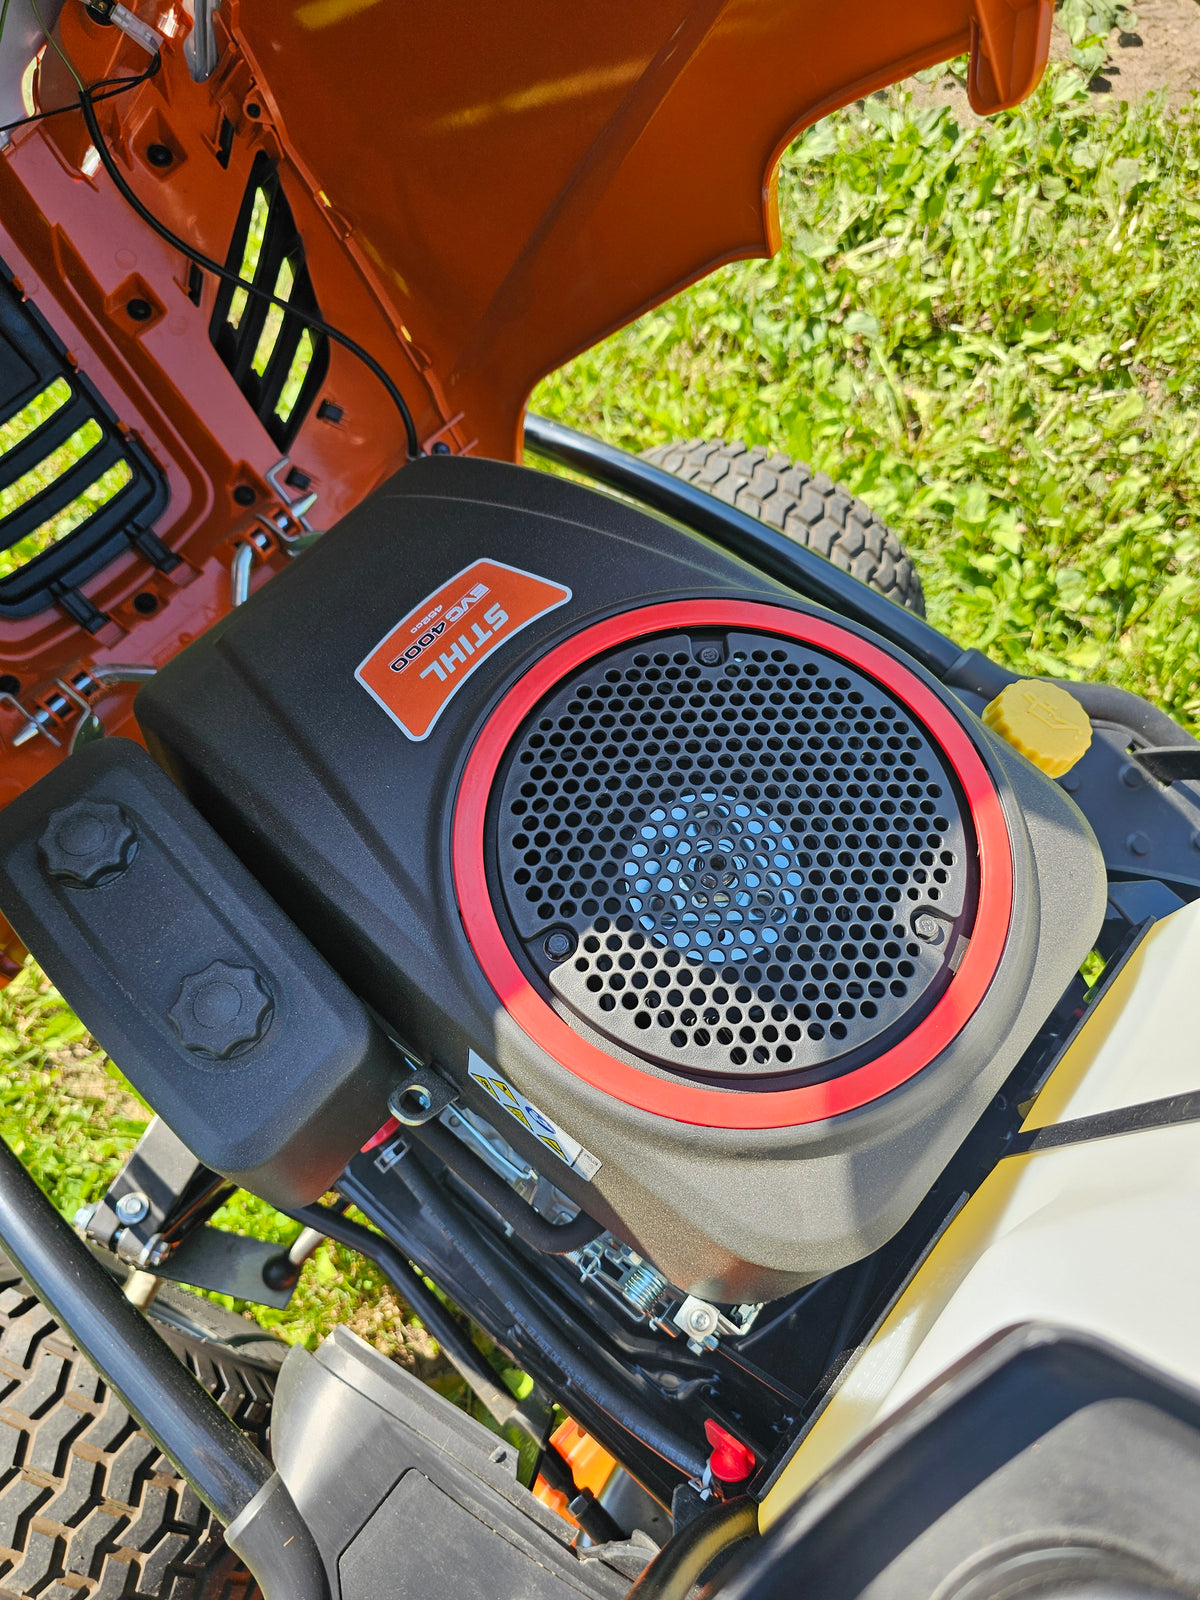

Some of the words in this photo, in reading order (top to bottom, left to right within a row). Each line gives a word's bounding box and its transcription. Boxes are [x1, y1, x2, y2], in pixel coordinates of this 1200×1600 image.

[410, 604, 443, 634] 452cc
[445, 583, 490, 622] EVC
[390, 620, 447, 673] 4000
[419, 602, 509, 682] STIHL
